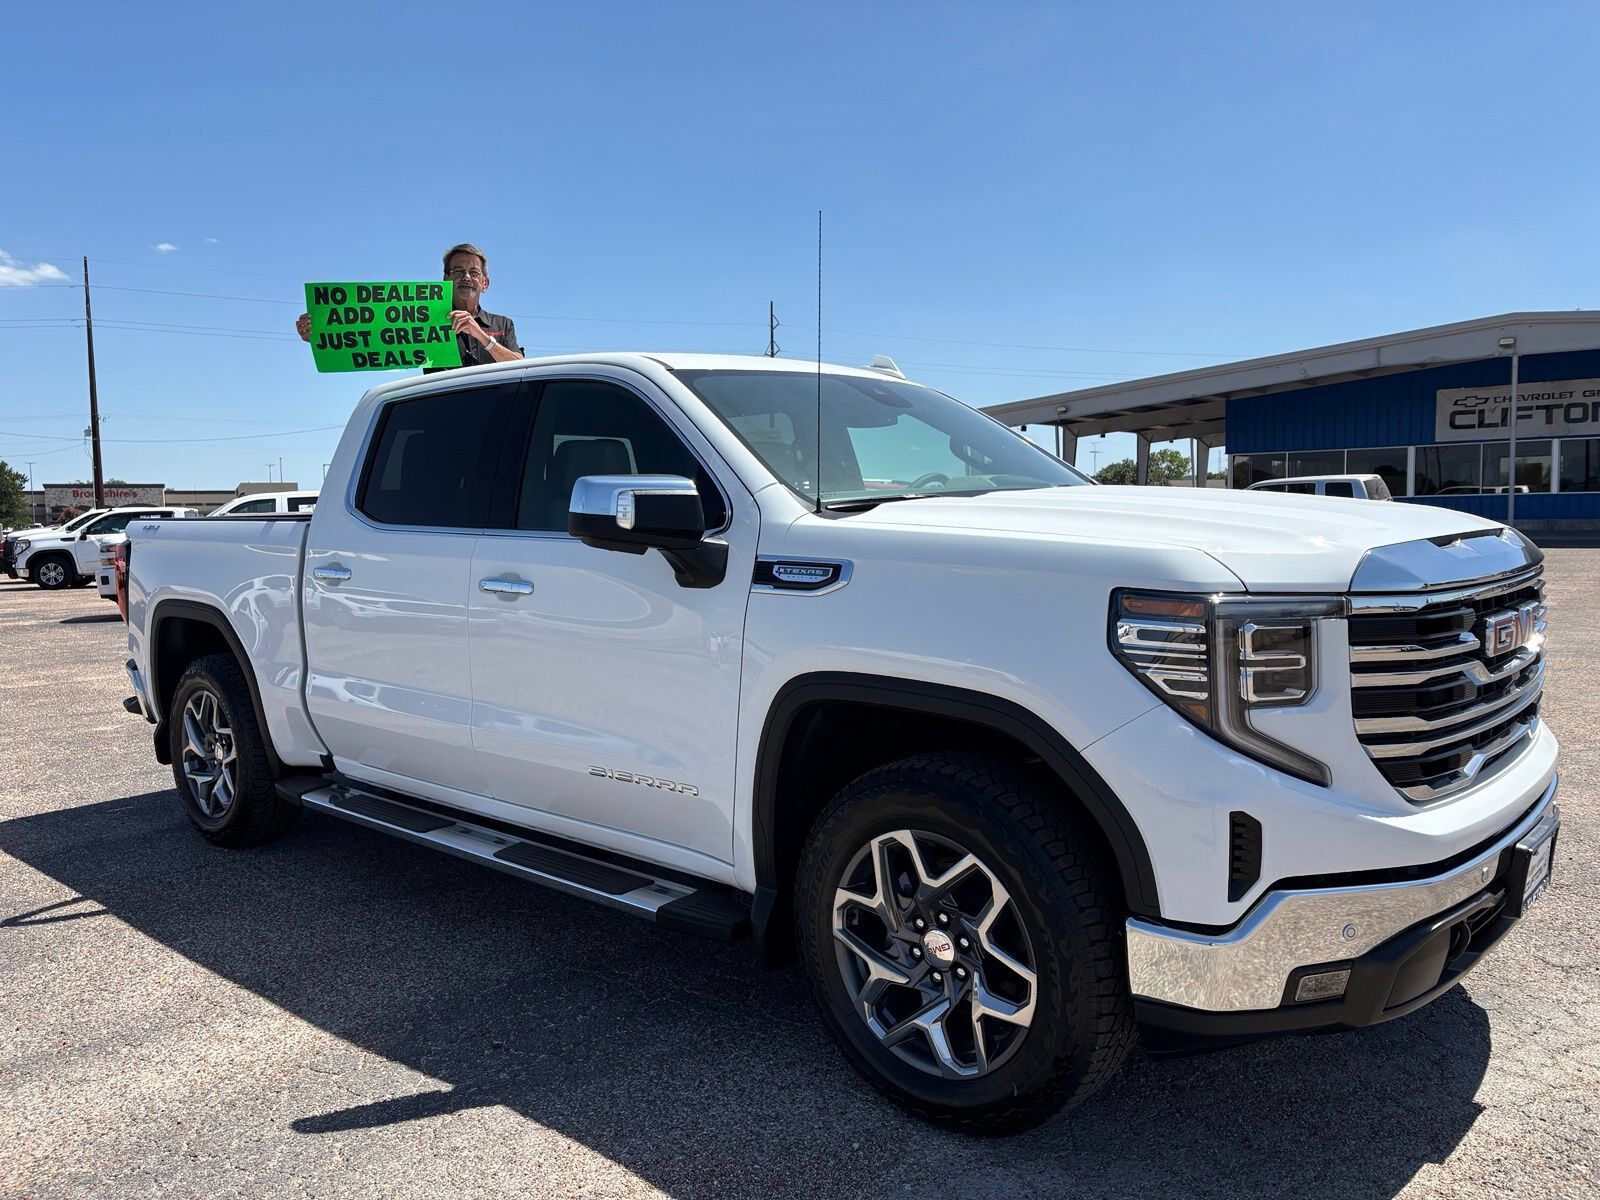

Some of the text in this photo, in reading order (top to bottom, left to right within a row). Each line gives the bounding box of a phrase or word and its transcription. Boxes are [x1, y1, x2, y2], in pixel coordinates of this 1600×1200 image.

[314, 285, 444, 306] NO DEALER
[326, 305, 430, 326] ADD ONS
[316, 325, 453, 350] JUST GREAT
[351, 350, 427, 368] DEALS
[587, 765, 699, 796] SIERRA
